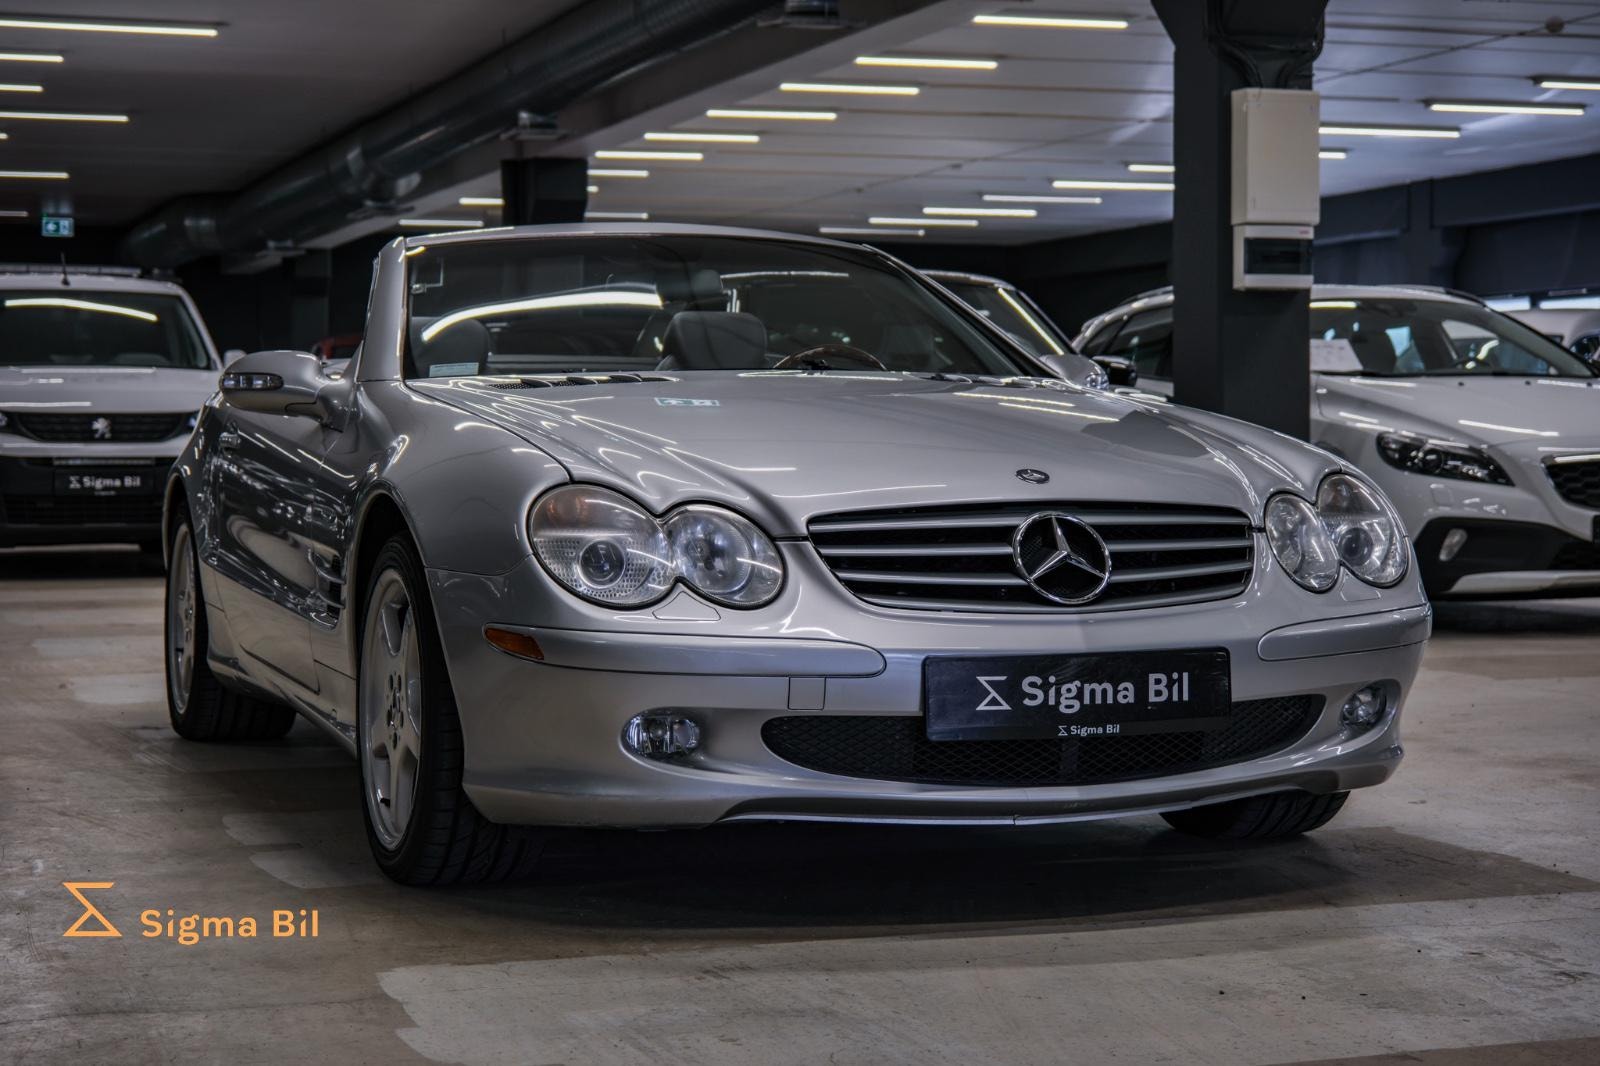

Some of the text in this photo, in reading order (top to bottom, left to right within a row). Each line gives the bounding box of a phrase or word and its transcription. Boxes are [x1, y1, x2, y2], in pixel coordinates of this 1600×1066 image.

[83, 475, 121, 490] Sigma
[1021, 671, 1189, 714] Sigma Bil
[1070, 724, 1120, 737] Sigma Bil
